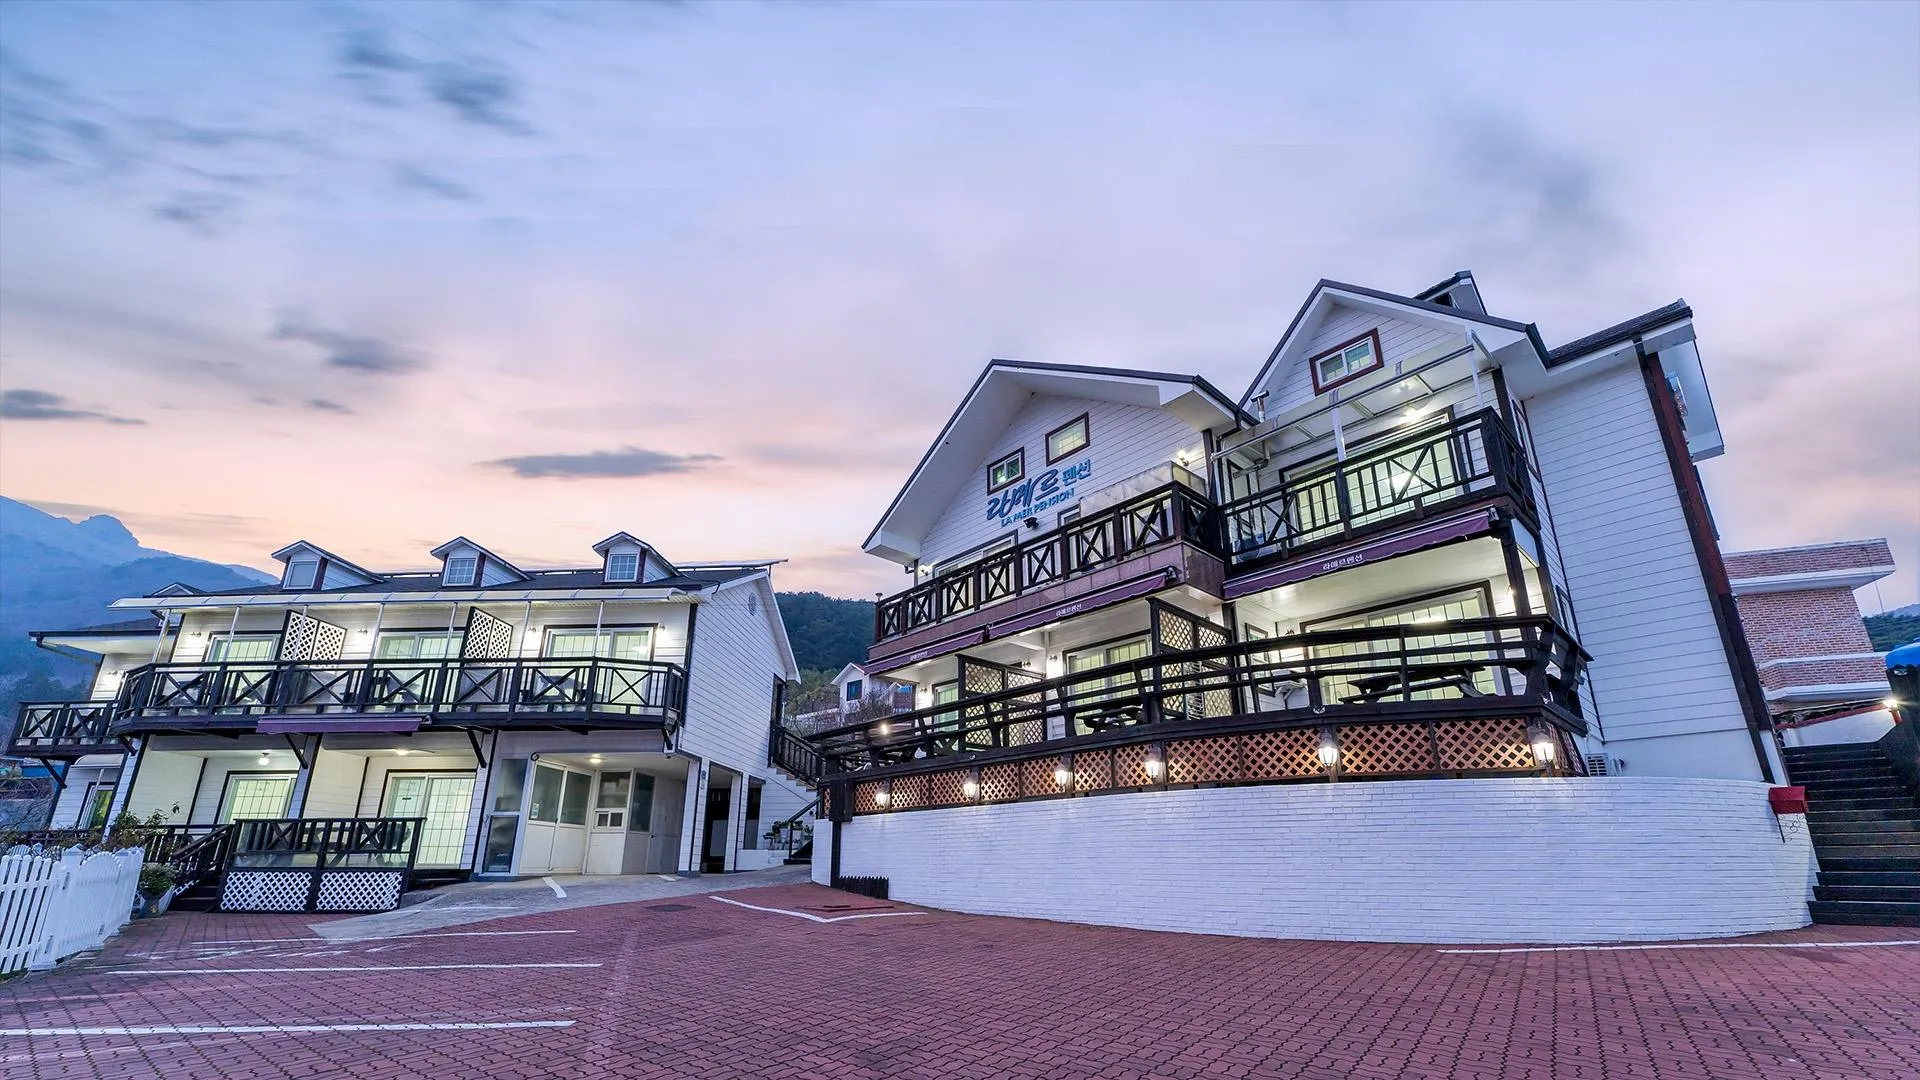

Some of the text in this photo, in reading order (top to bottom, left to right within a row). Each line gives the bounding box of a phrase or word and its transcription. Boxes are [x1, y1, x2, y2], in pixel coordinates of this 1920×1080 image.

[1061, 459, 1091, 486] 펜션
[1013, 507, 1033, 520] MER
[1034, 487, 1075, 513] PENSION
